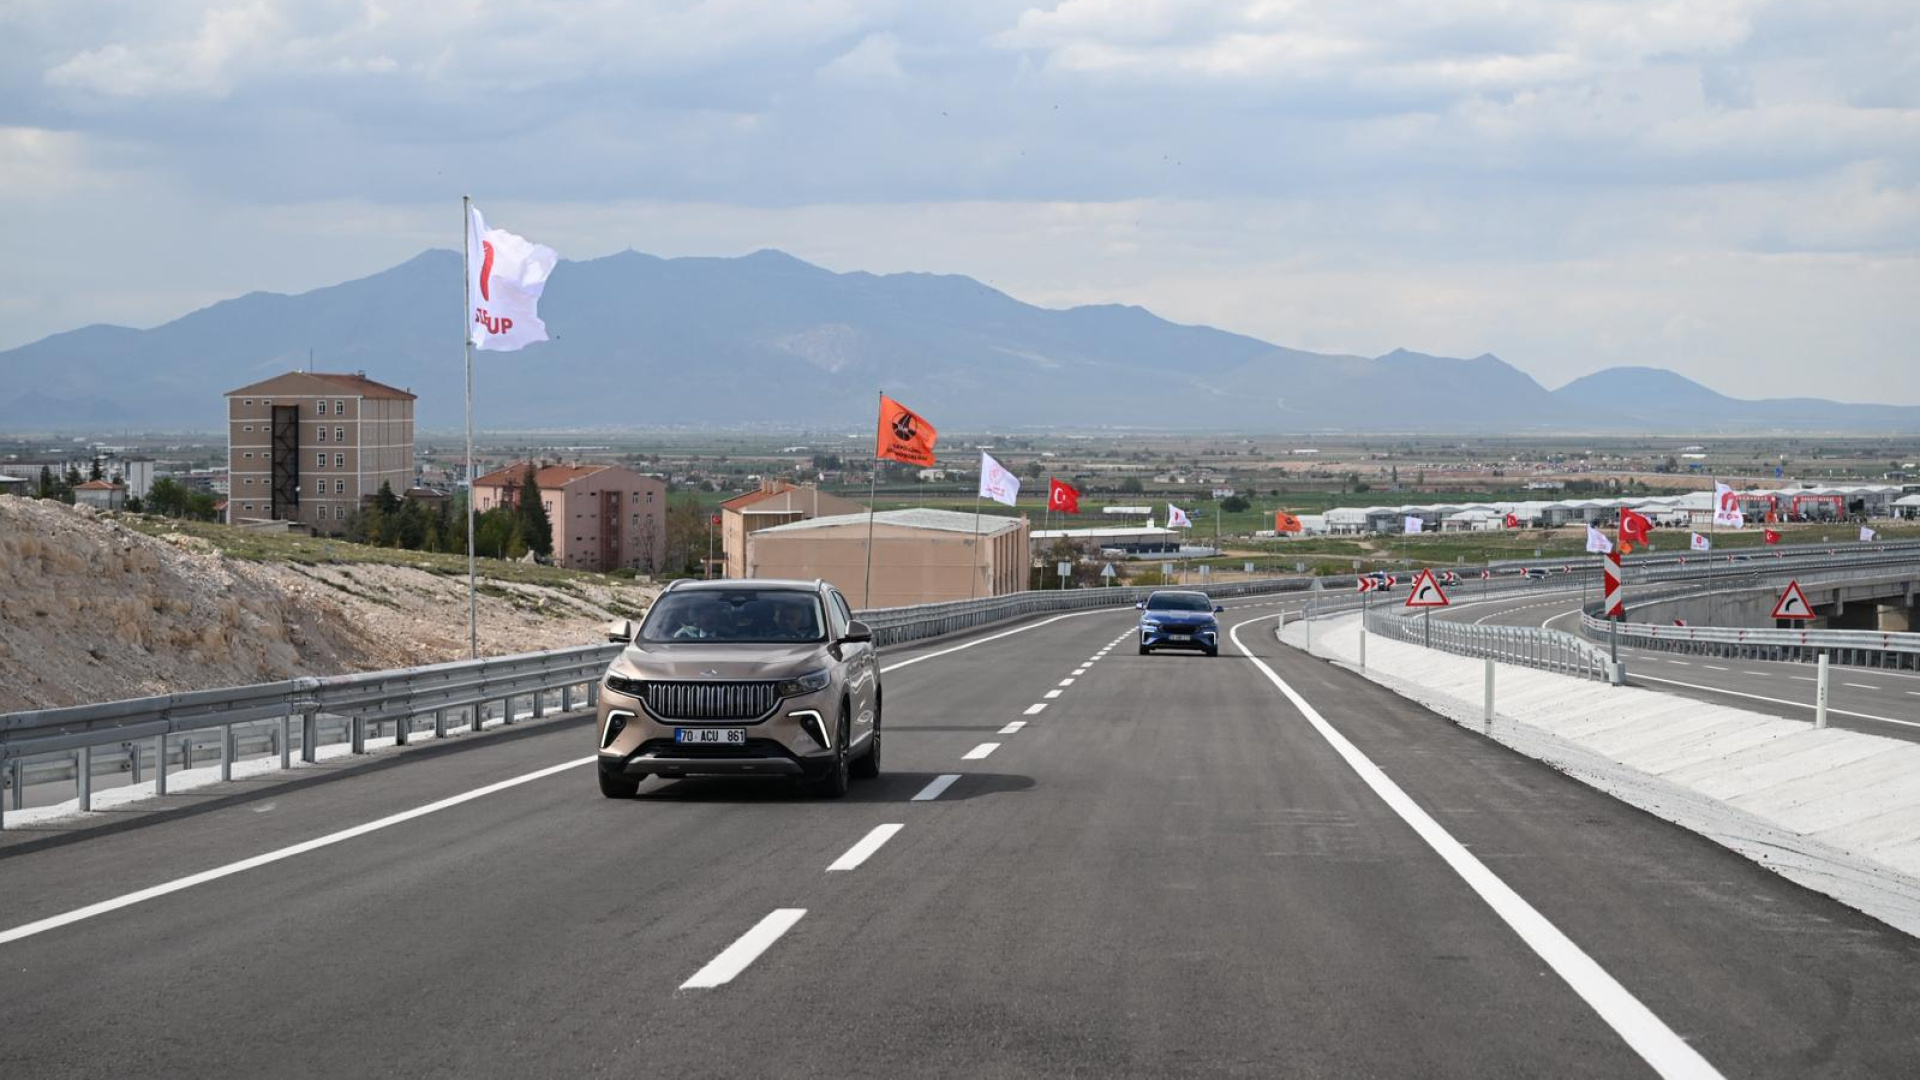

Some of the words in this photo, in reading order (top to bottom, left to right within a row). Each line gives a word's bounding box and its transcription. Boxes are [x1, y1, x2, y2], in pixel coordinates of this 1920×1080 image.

[682, 730, 693, 741] 70
[701, 730, 718, 741] ACU
[728, 730, 743, 741] 861
